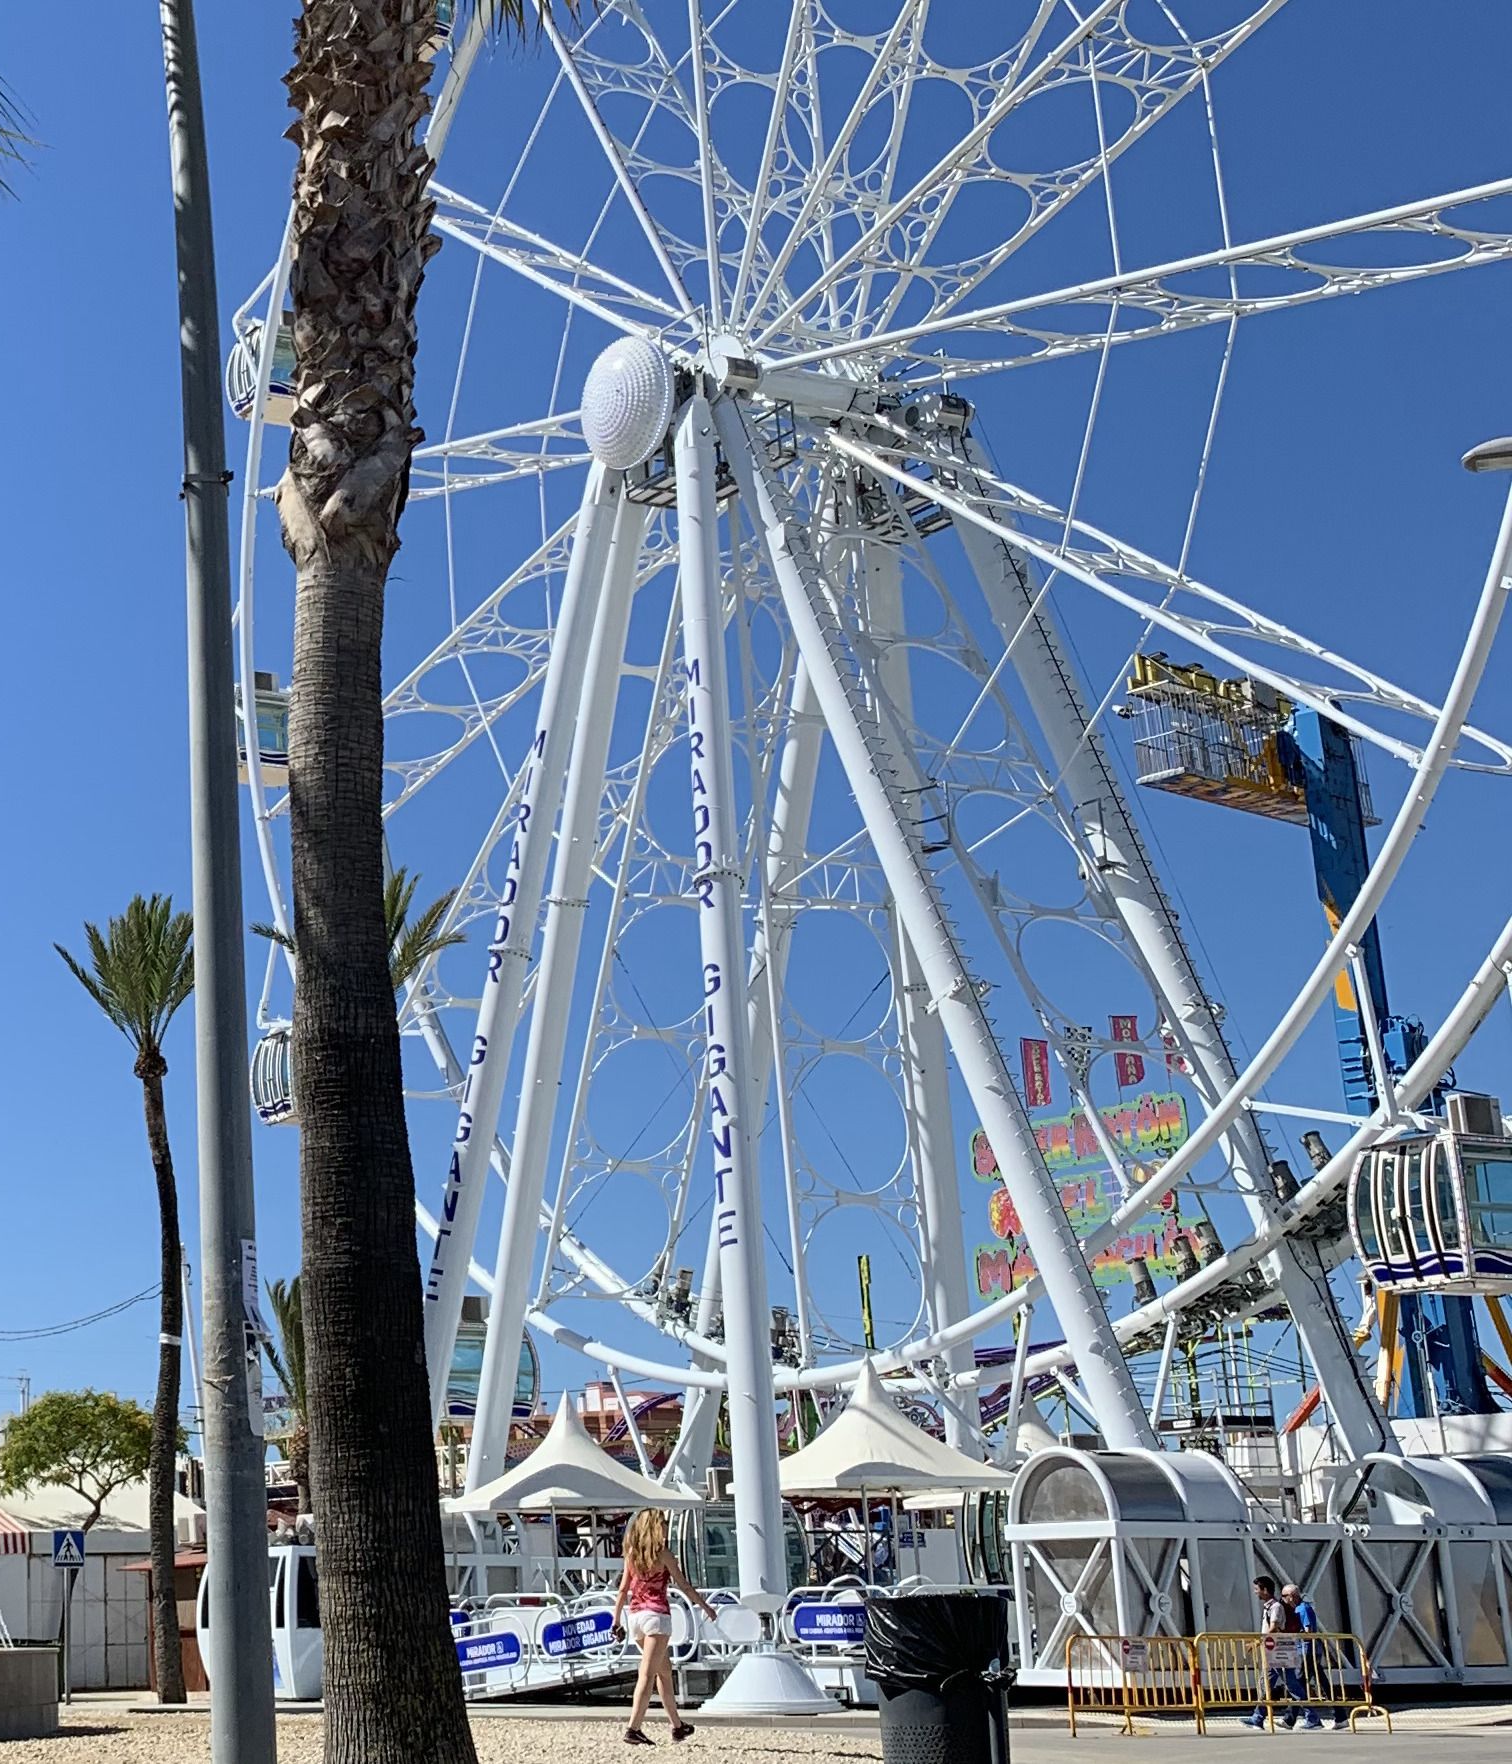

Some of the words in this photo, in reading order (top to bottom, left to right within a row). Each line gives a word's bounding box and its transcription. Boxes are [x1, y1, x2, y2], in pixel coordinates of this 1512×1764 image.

[488, 729, 547, 983] MIRADOR
[688, 658, 715, 909] MIRADOR
[703, 963, 738, 1248] GIGANTE
[426, 1035, 488, 1301] GIGANTE
[562, 1618, 596, 1636] NOVEDAD
[816, 1613, 855, 1627] MIRADOR
[466, 1643, 497, 1659] MIRADOR
[548, 1637, 581, 1654] MIRADOR
[582, 1629, 614, 1646] GIGANTE
